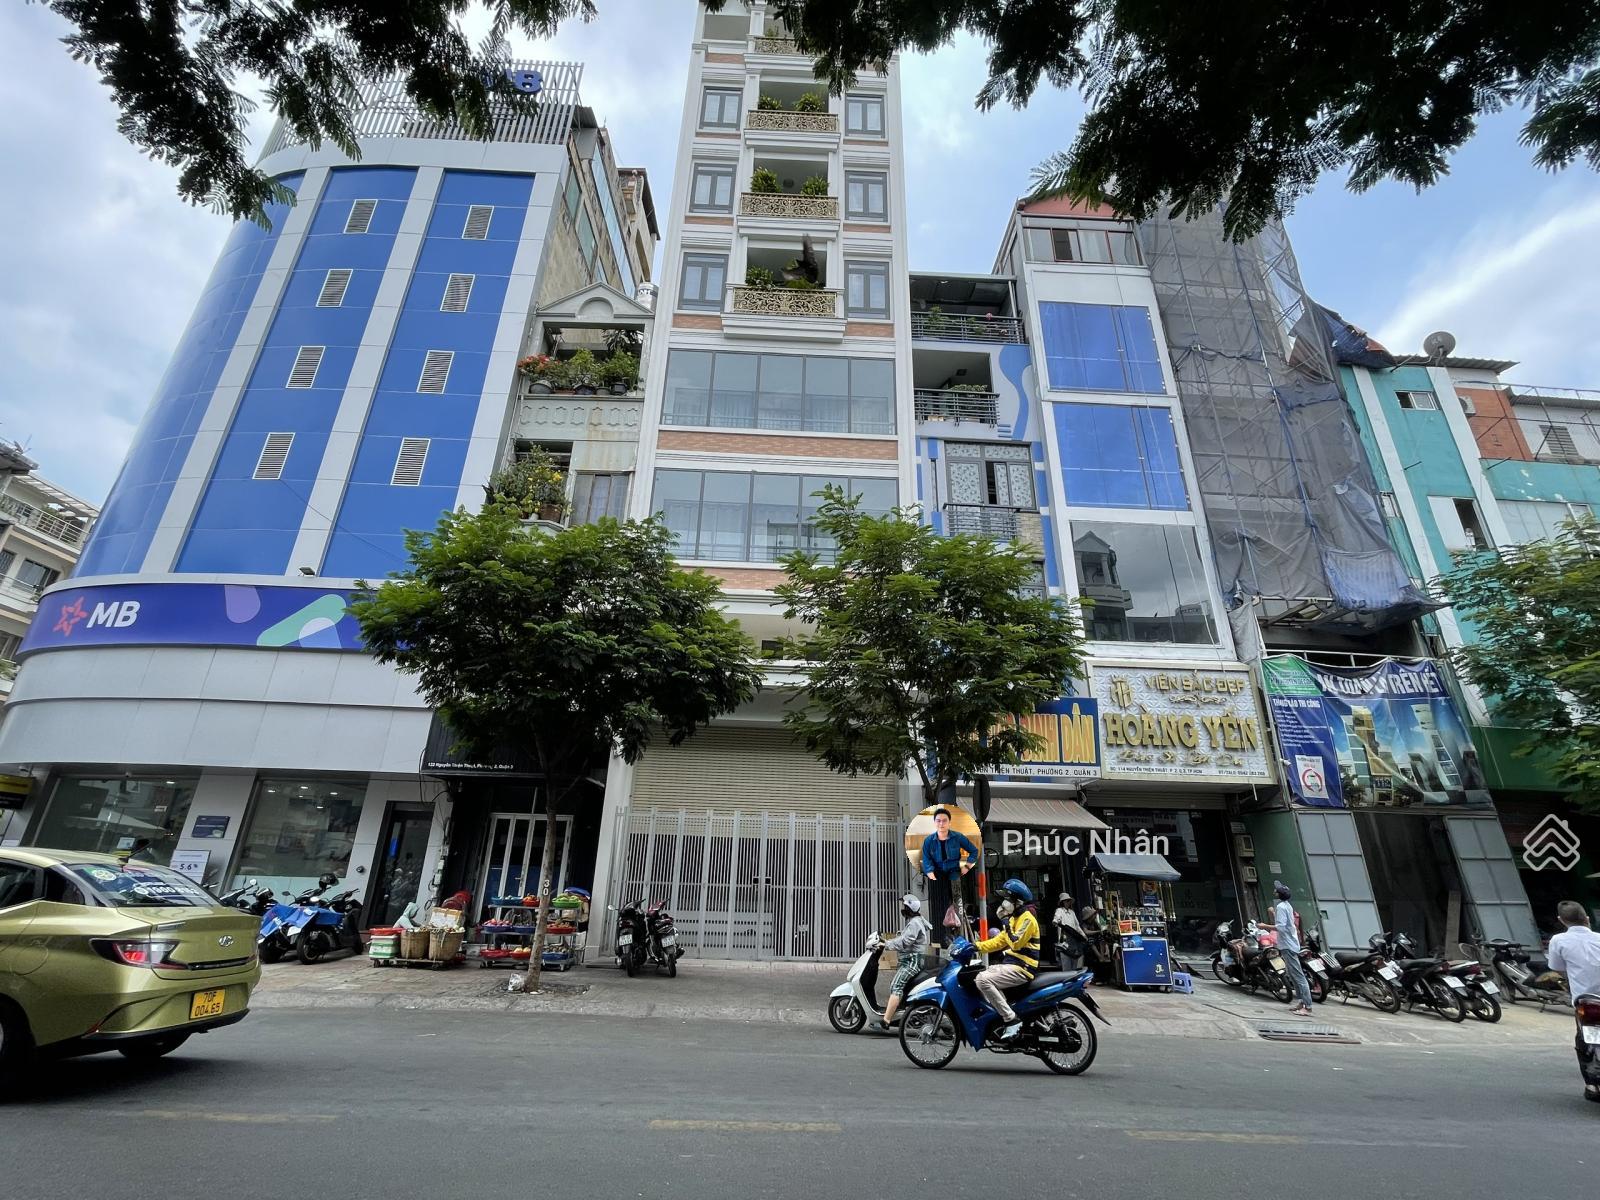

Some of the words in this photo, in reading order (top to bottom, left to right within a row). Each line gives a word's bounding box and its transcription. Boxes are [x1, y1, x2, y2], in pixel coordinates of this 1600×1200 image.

[86, 600, 141, 628] MB
[1143, 673, 1179, 694] VIỆN
[1216, 677, 1246, 695] ĐẸP
[1060, 703, 1097, 763] DÂN
[1103, 704, 1198, 748] HOÀNG
[1201, 706, 1259, 752] YẾN
